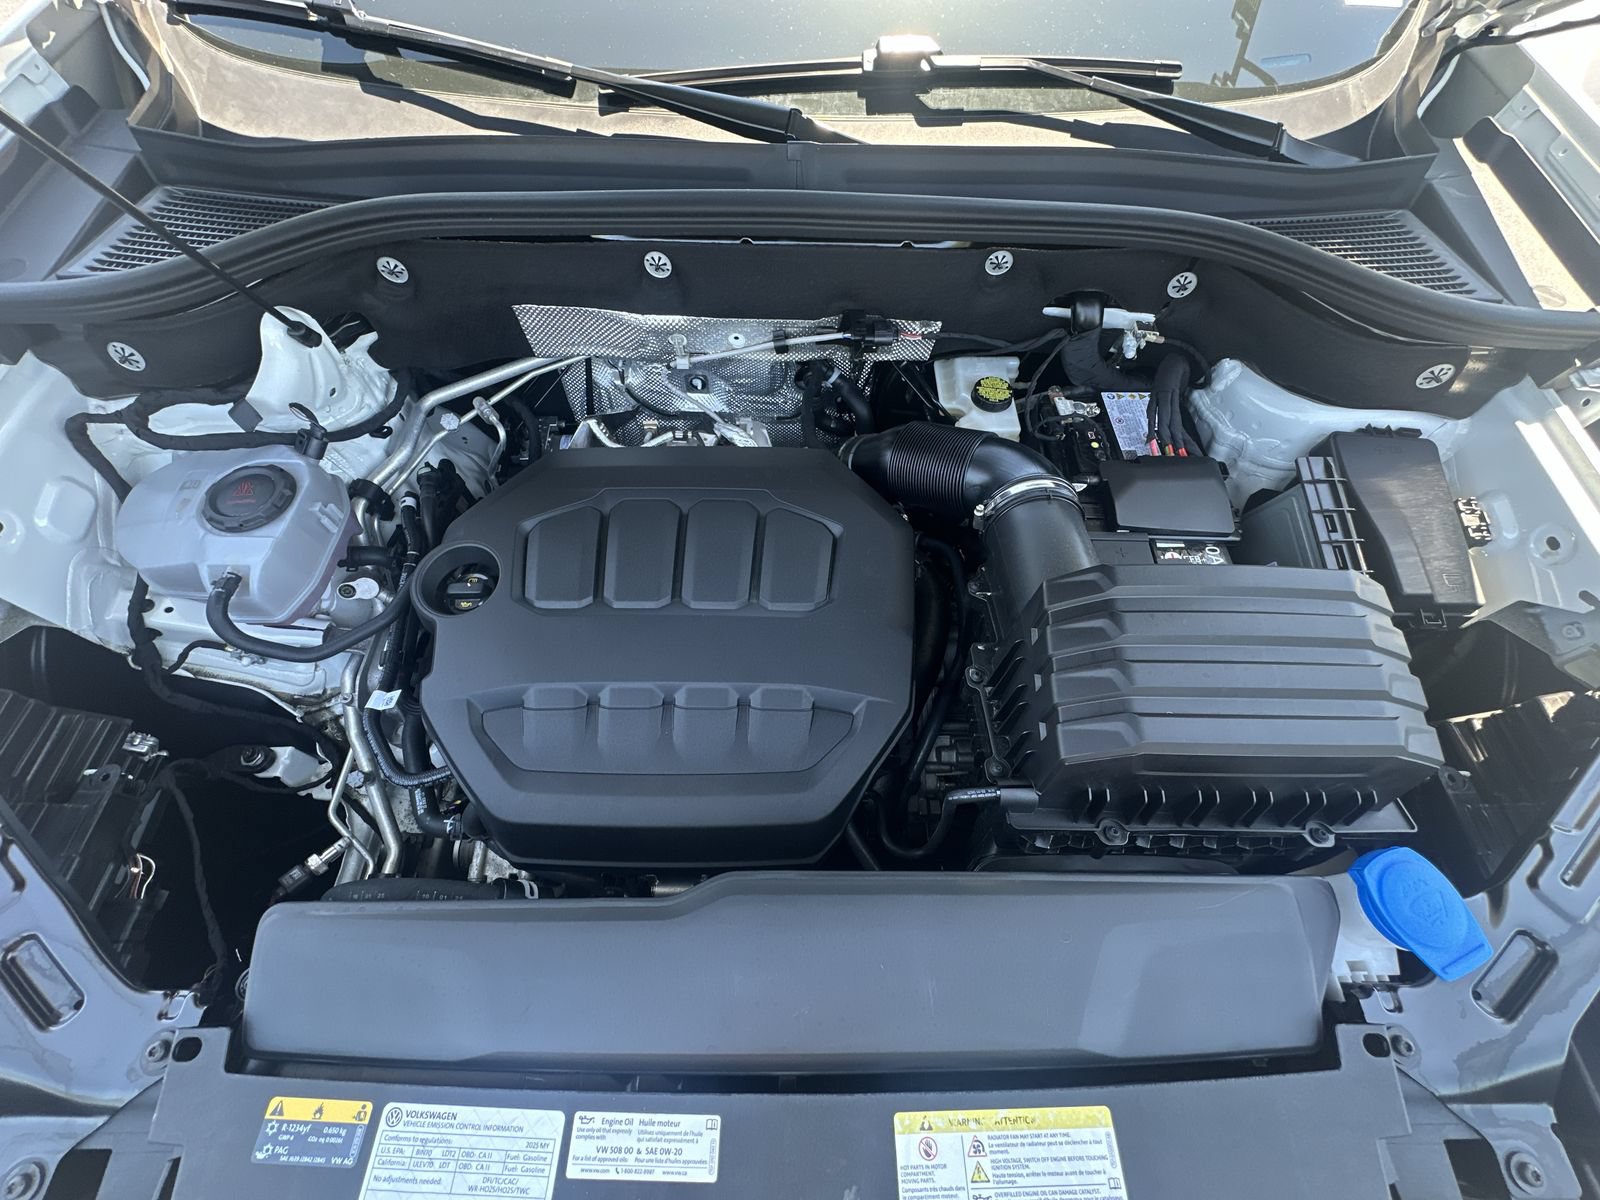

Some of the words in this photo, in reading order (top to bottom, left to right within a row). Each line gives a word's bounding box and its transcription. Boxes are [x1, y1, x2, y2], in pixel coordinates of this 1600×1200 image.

[405, 1110, 458, 1121] VOLKSWAGEN
[403, 1120, 426, 1128] VEHICLE
[427, 1121, 455, 1129] EMISSION
[456, 1122, 481, 1131] CONTROL
[483, 1124, 524, 1132] INFORMATION
[602, 1117, 623, 1128] Engine
[624, 1118, 634, 1126] Oil
[639, 1118, 656, 1126] Huile
[281, 1123, 312, 1135] R-1234yf
[339, 1128, 348, 1137] kg
[612, 1128, 632, 1136] expressly
[384, 1134, 411, 1142] Conforms
[274, 1145, 289, 1154] PAG
[596, 1146, 609, 1154] VW
[610, 1146, 623, 1154] 508
[624, 1147, 634, 1155] 00
[645, 1147, 658, 1155] SAE
[660, 1148, 683, 1156] 0W-20
[523, 1154, 548, 1162] Gasoline
[438, 1161, 451, 1169] LDT
[521, 1166, 546, 1174] Gasoline
[382, 1176, 417, 1185] adjustments
[902, 1186, 929, 1194] Composants
